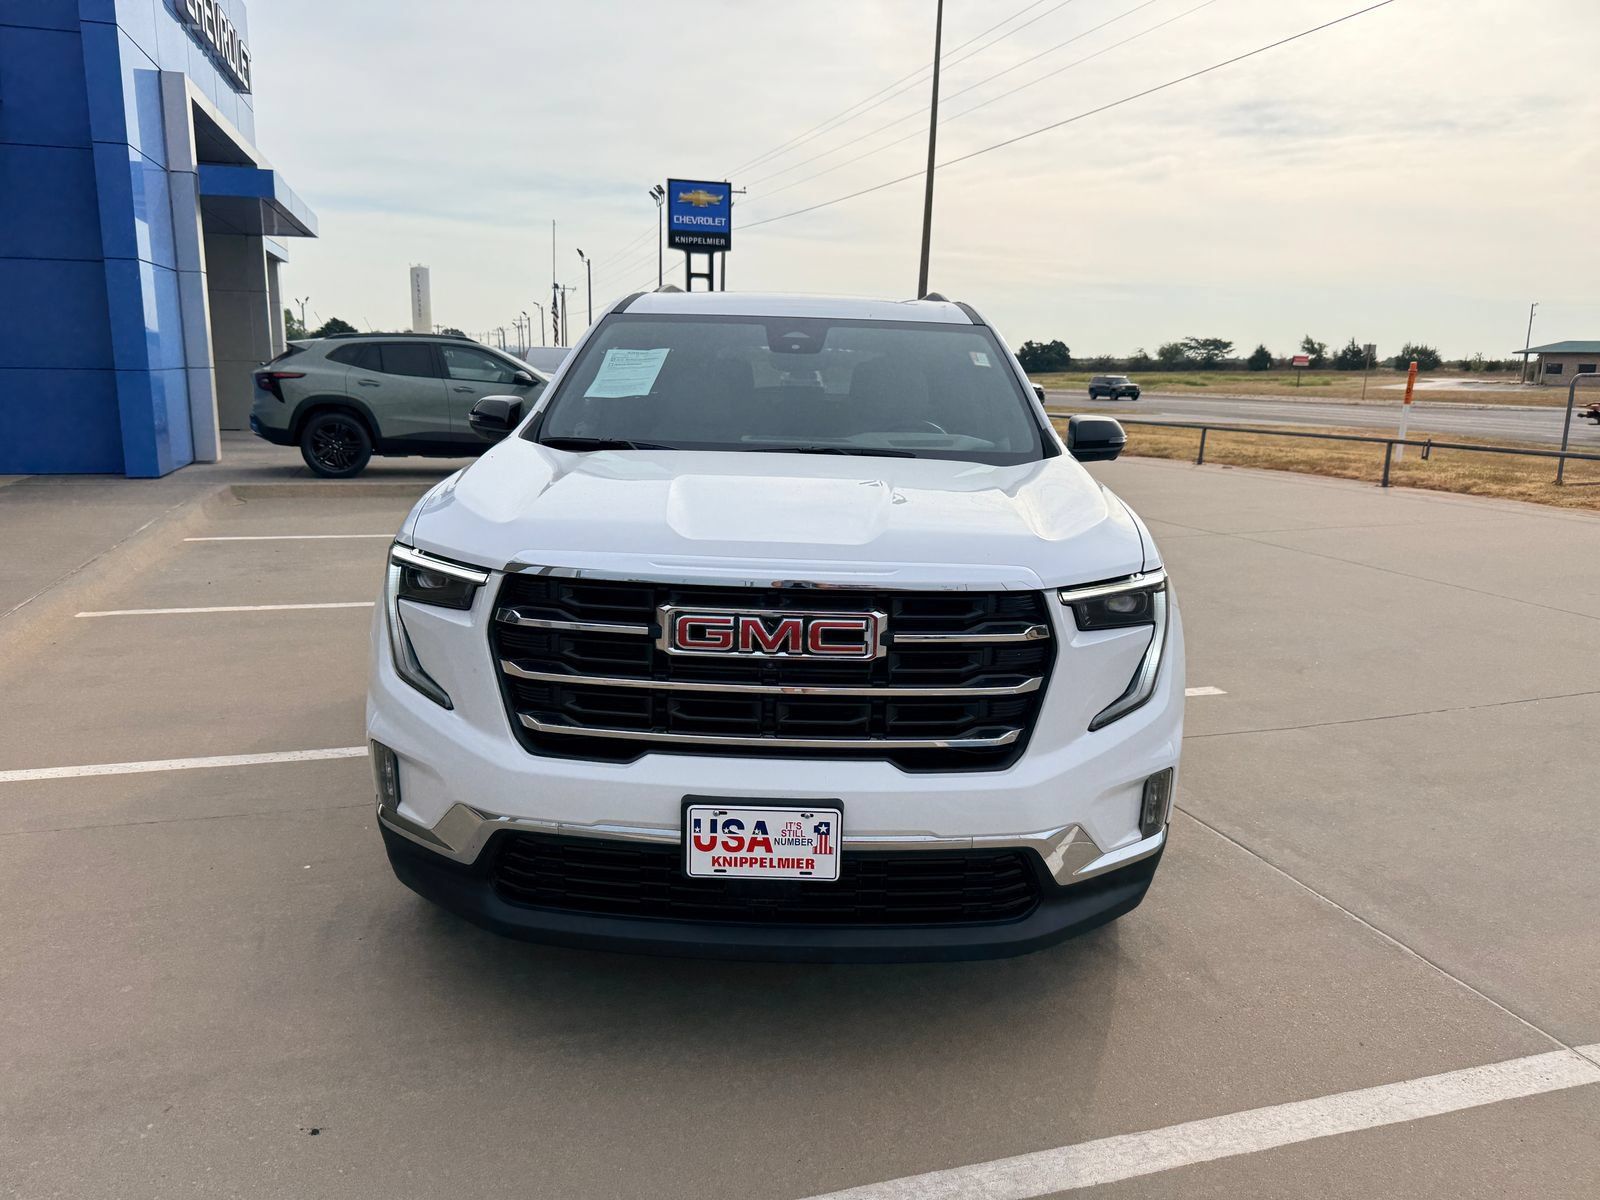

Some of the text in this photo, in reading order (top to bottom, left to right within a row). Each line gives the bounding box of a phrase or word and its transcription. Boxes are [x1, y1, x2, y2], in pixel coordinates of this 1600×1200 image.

[184, 0, 252, 91] EVROLET
[673, 215, 727, 226] CHEVROLET
[675, 236, 726, 246] KNIPPELMIER
[676, 615, 867, 655] GMC
[785, 821, 803, 830] IT'S
[693, 818, 774, 854] USA
[780, 829, 806, 838] STILL
[812, 821, 834, 855] 1
[774, 837, 813, 846] NUMBER
[711, 855, 815, 870] KNIPPELMIER
